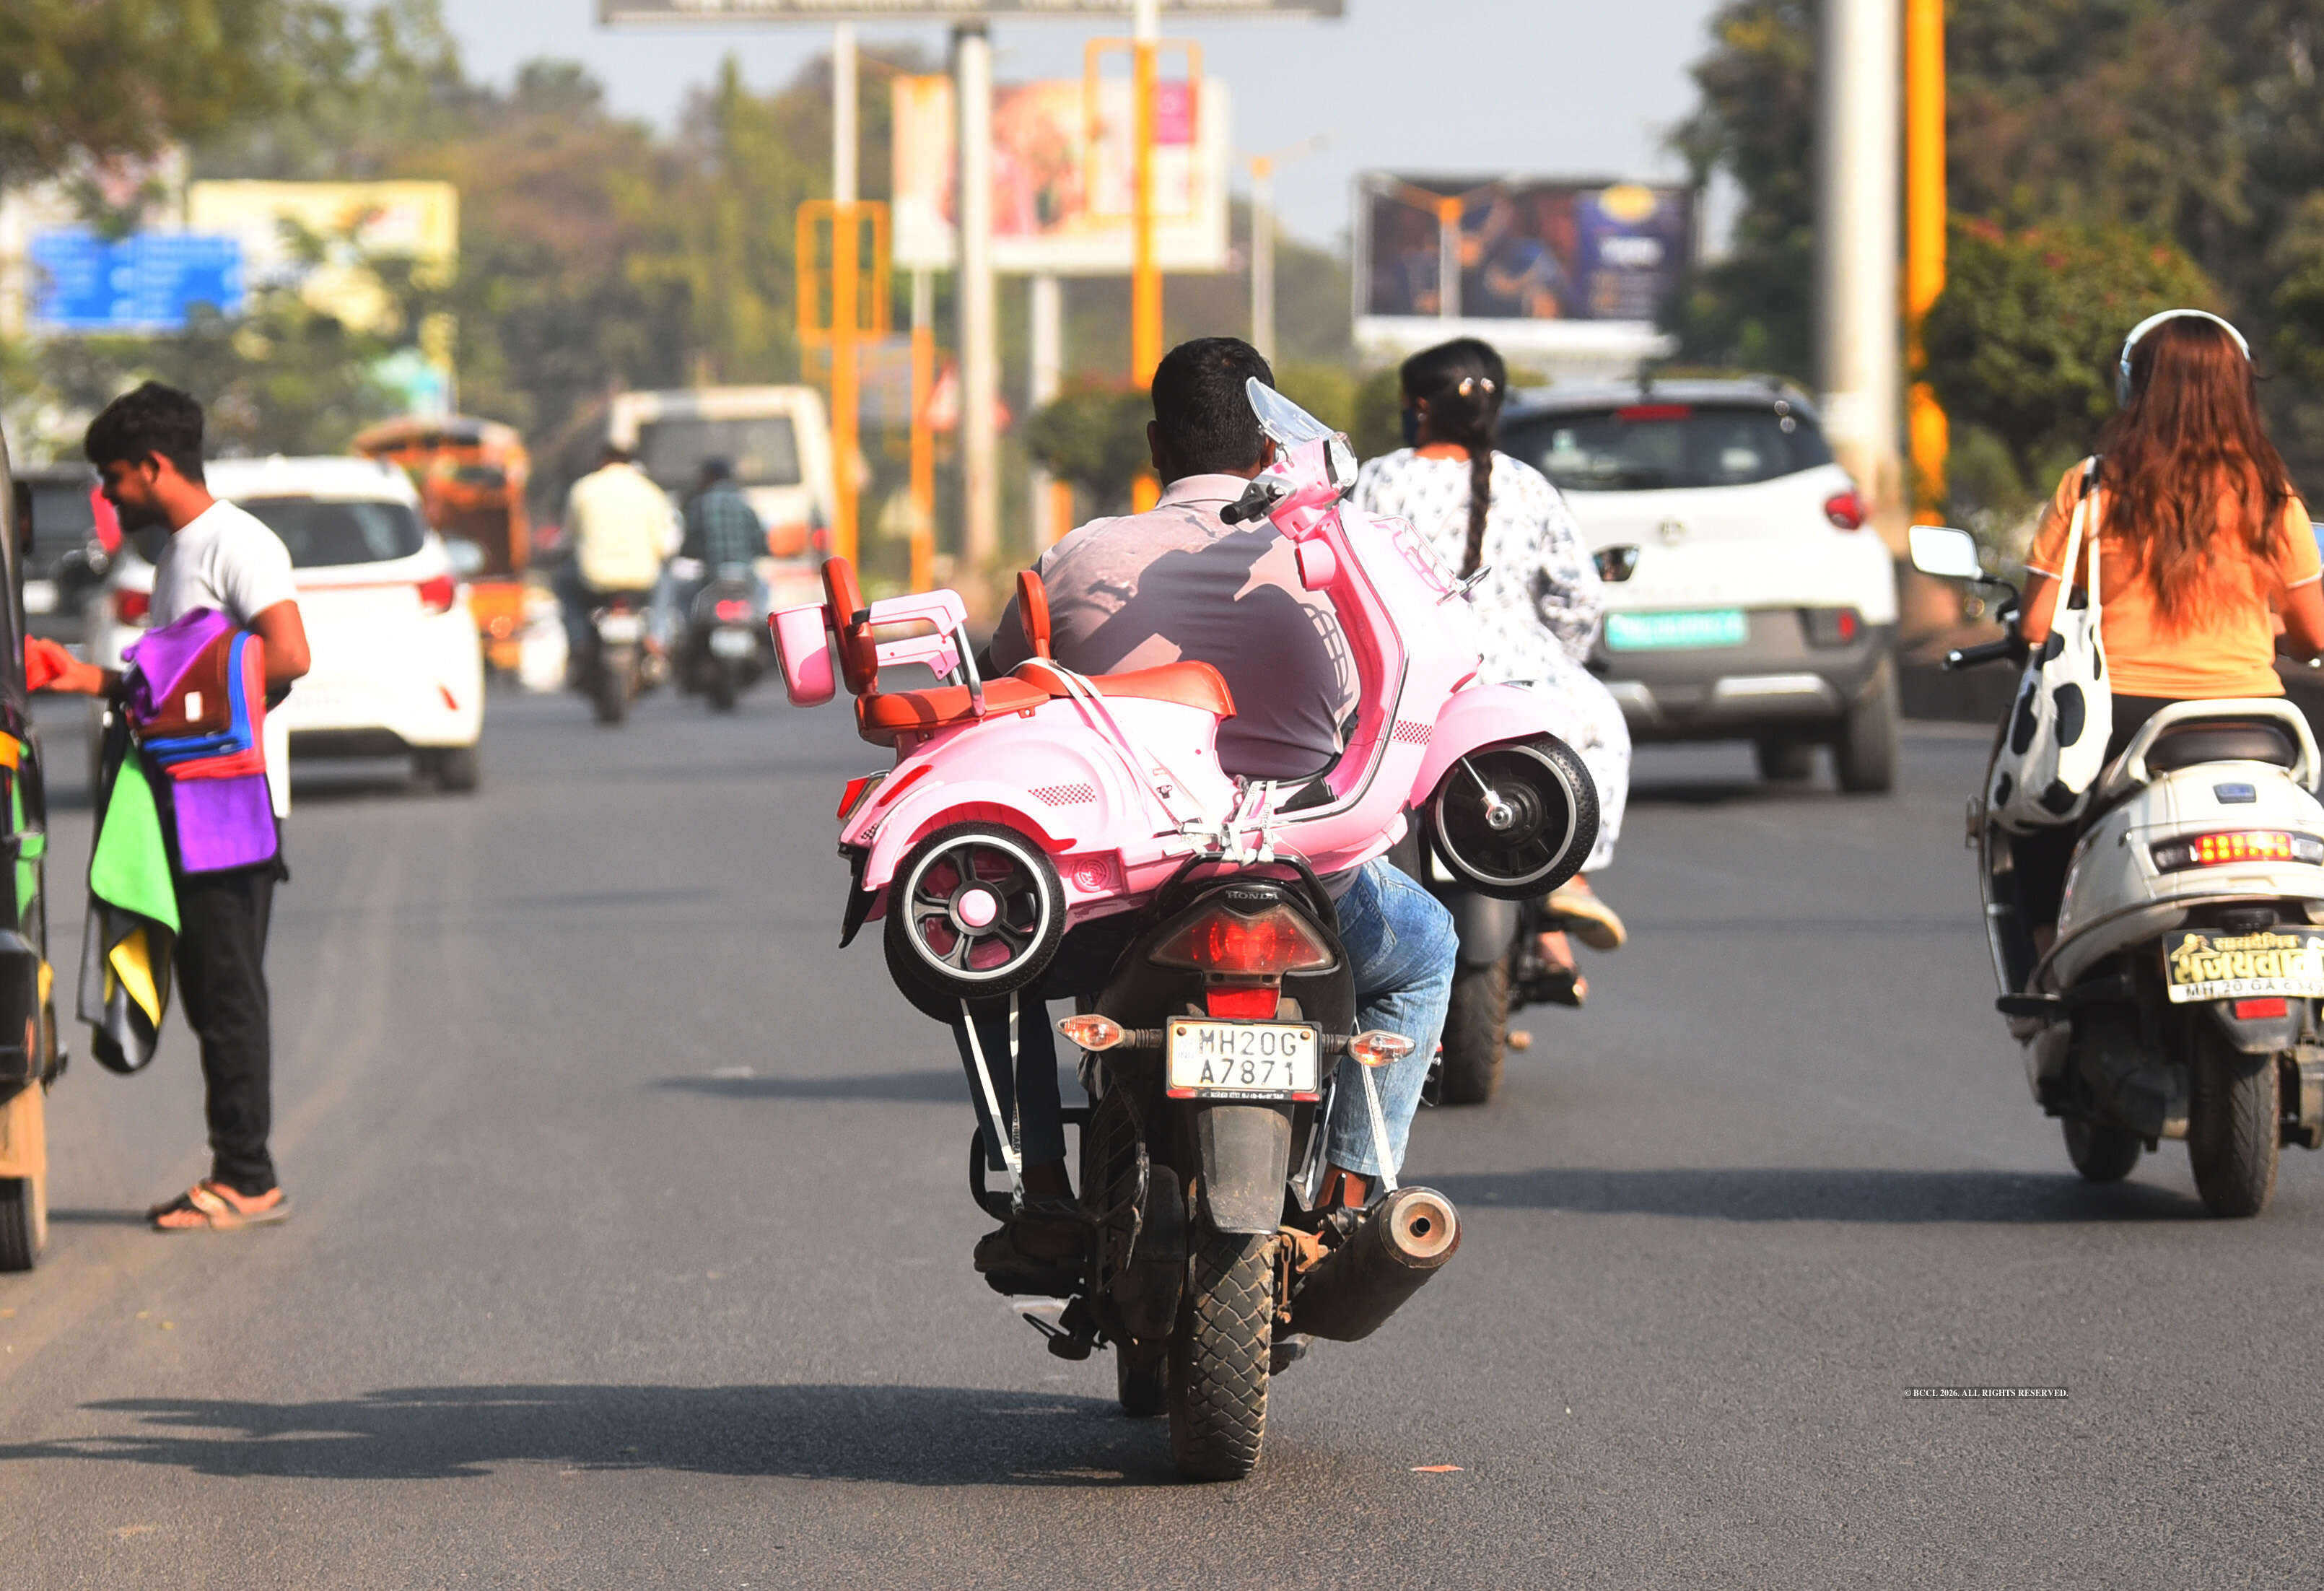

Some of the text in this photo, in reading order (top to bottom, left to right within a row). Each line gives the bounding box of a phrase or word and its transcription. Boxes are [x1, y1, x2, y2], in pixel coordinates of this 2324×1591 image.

[1226, 890, 1279, 899] HONDA
[2185, 984, 2214, 998] MH
[1199, 1029, 1296, 1056] MH20G
[1200, 1059, 1293, 1086] A7871
